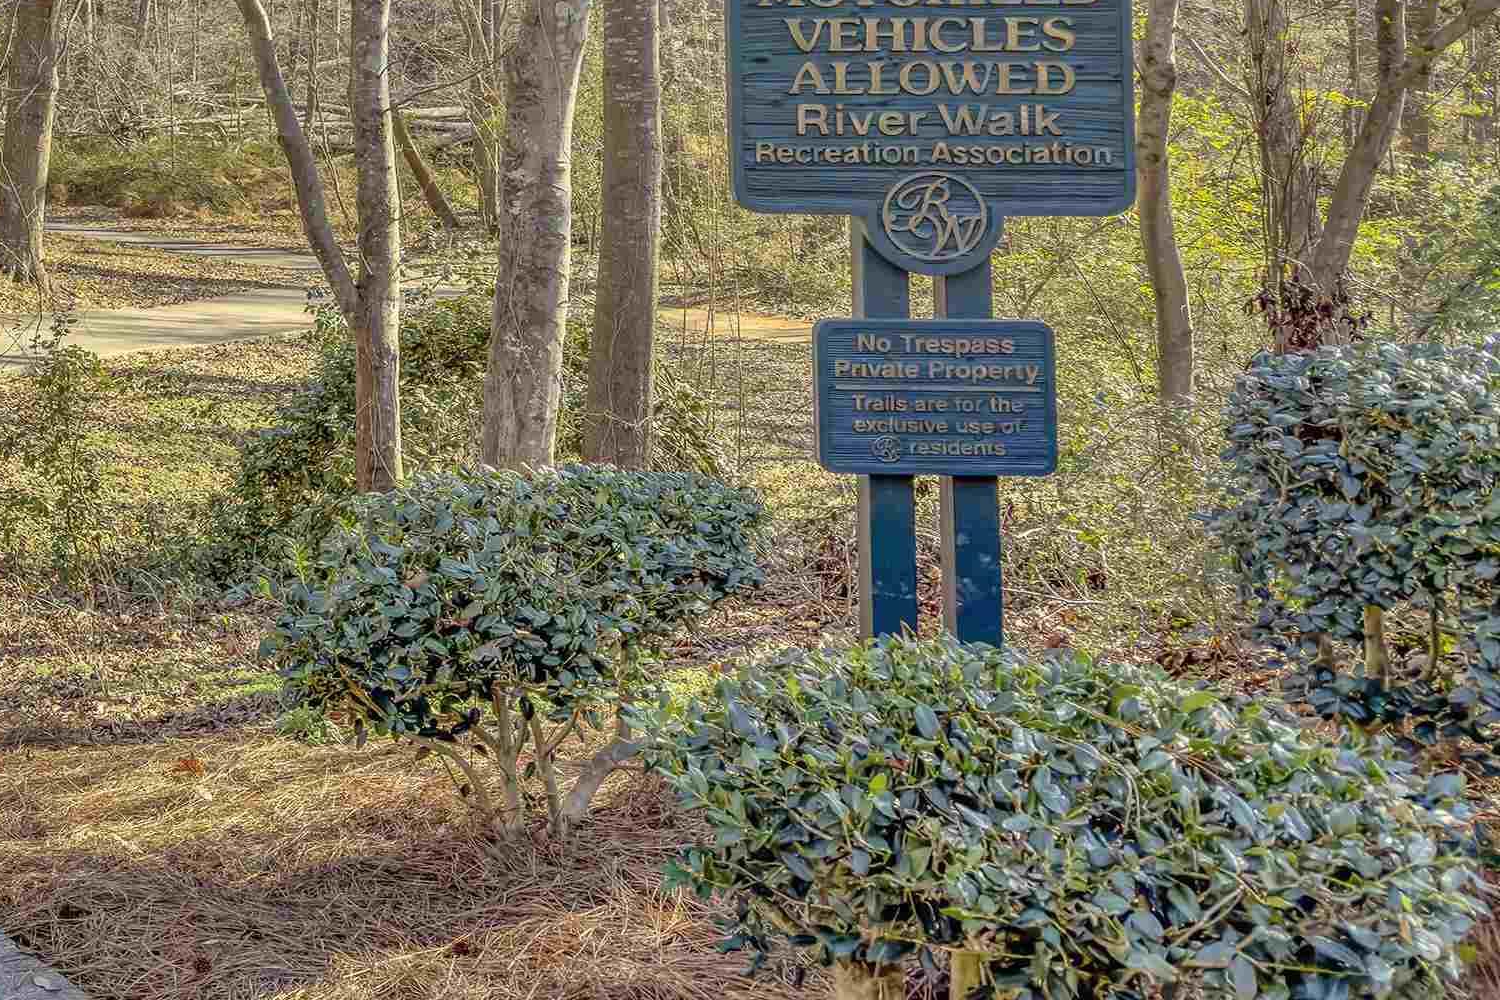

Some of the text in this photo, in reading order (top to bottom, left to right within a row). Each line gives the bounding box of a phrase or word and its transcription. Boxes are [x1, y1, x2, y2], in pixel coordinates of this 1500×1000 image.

[783, 15, 1077, 53] VEHICLES
[788, 59, 1076, 96] ALLOWED
[796, 102, 1063, 137] River Walk
[755, 141, 1113, 167] Recreation Association
[856, 334, 1016, 358] No Trespass
[835, 360, 1039, 385] Private Property
[852, 394, 1025, 414] Trails are for the
[852, 418, 1026, 435] exclusive use of
[908, 439, 1007, 457] residents
